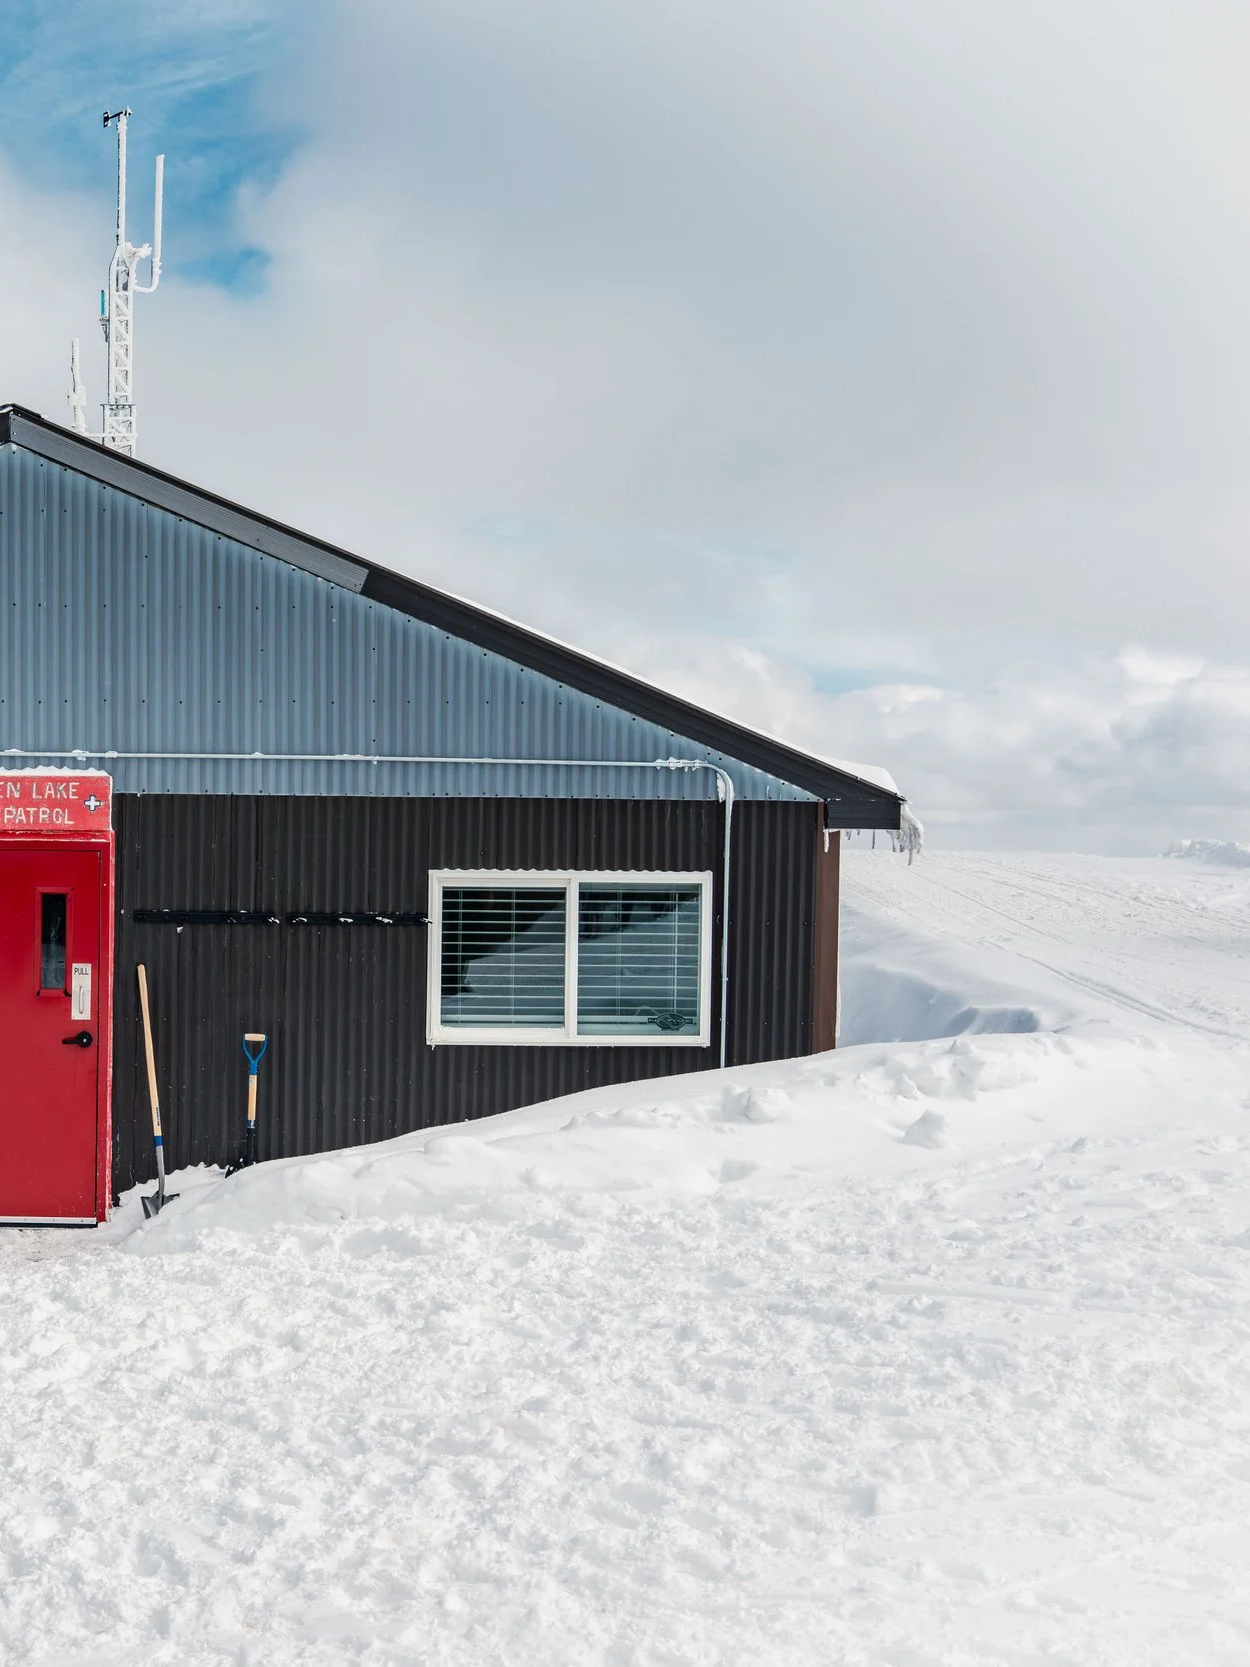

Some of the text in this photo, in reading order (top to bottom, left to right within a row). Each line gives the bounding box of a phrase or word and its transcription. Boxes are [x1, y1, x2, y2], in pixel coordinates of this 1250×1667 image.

[32, 781, 80, 799] LAKE
[3, 807, 75, 824] PATROL
[74, 967, 89, 975] PULL
